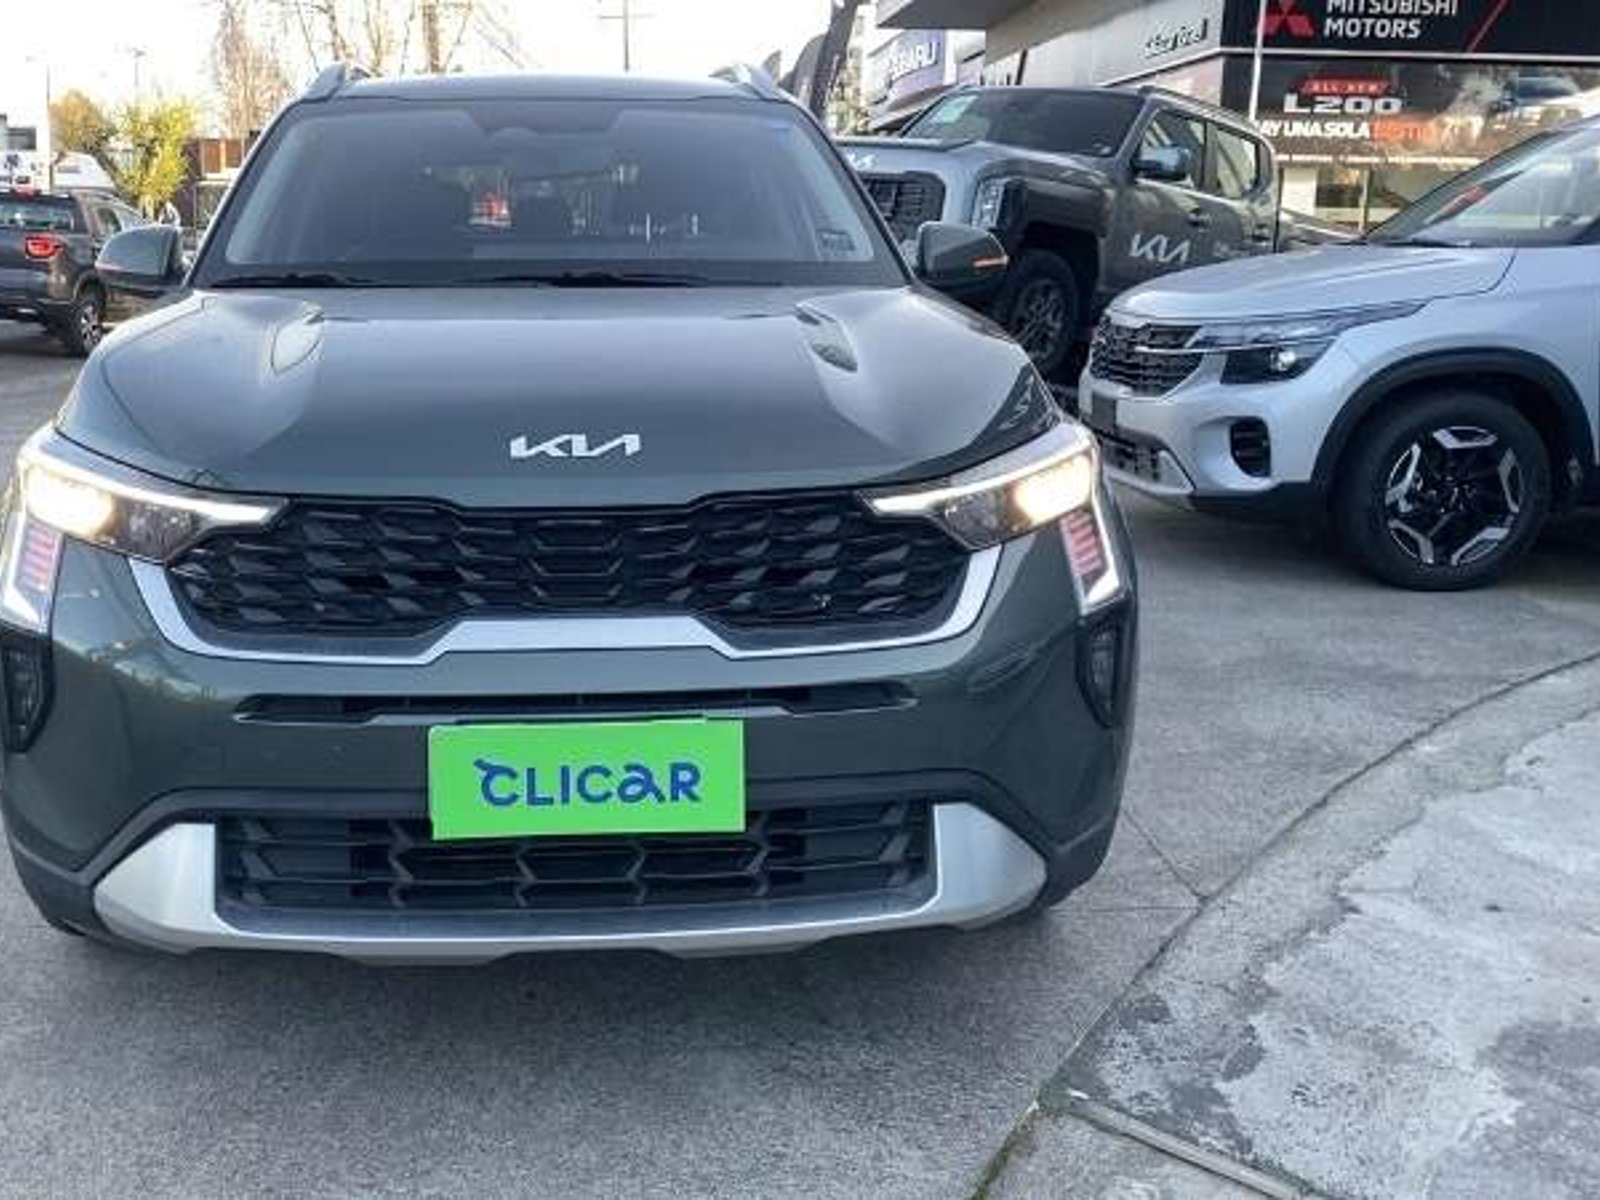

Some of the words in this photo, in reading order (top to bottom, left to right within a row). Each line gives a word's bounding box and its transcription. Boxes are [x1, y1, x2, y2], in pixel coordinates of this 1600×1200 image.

[1326, 0, 1458, 15] MITSUBISHI
[1324, 17, 1422, 38] MOTORS
[1283, 92, 1402, 113] L200
[1283, 119, 1322, 138] UNA
[1323, 120, 1371, 138] SOLA
[1129, 233, 1191, 264] KIA
[510, 433, 640, 459] KIA
